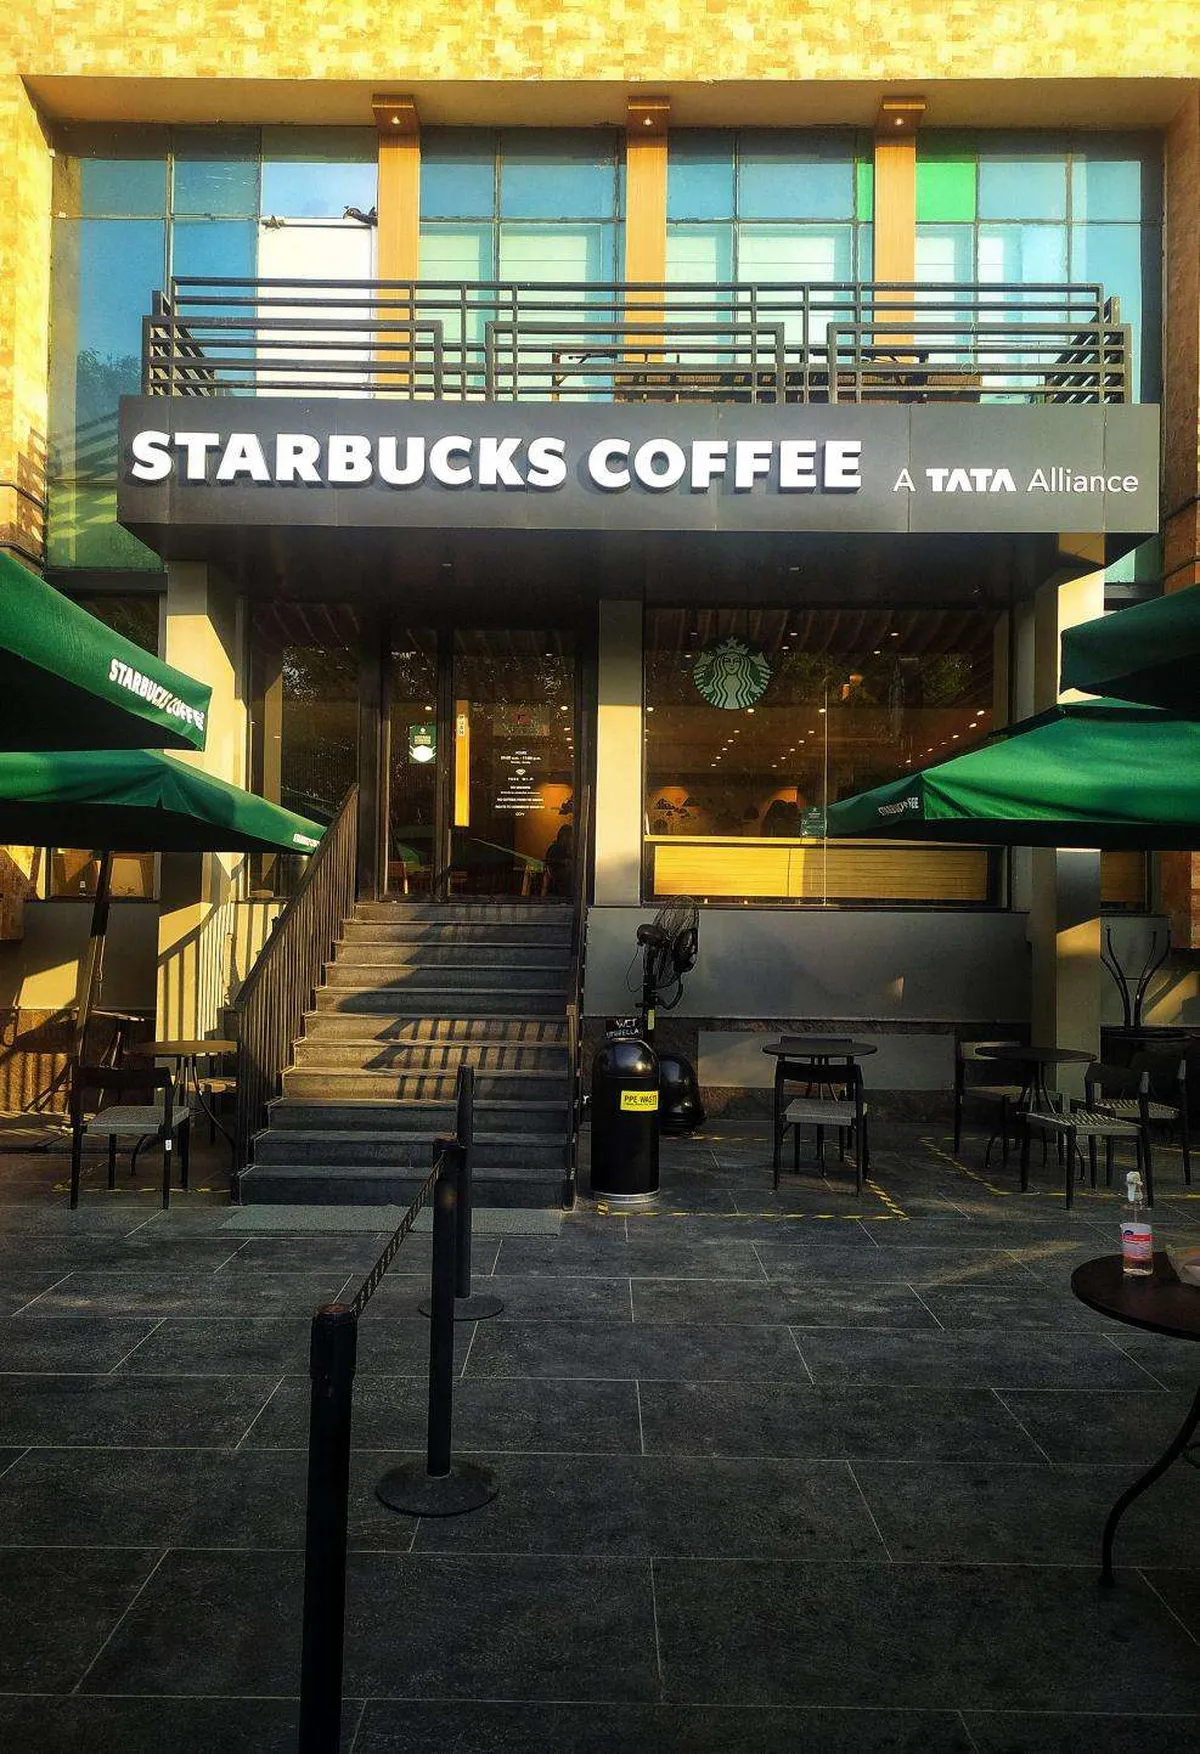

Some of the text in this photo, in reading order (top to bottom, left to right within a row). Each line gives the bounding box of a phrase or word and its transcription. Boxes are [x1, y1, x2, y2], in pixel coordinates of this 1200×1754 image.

[131, 430, 1139, 492] STARBUCKS COFFEE A TATA Alliance
